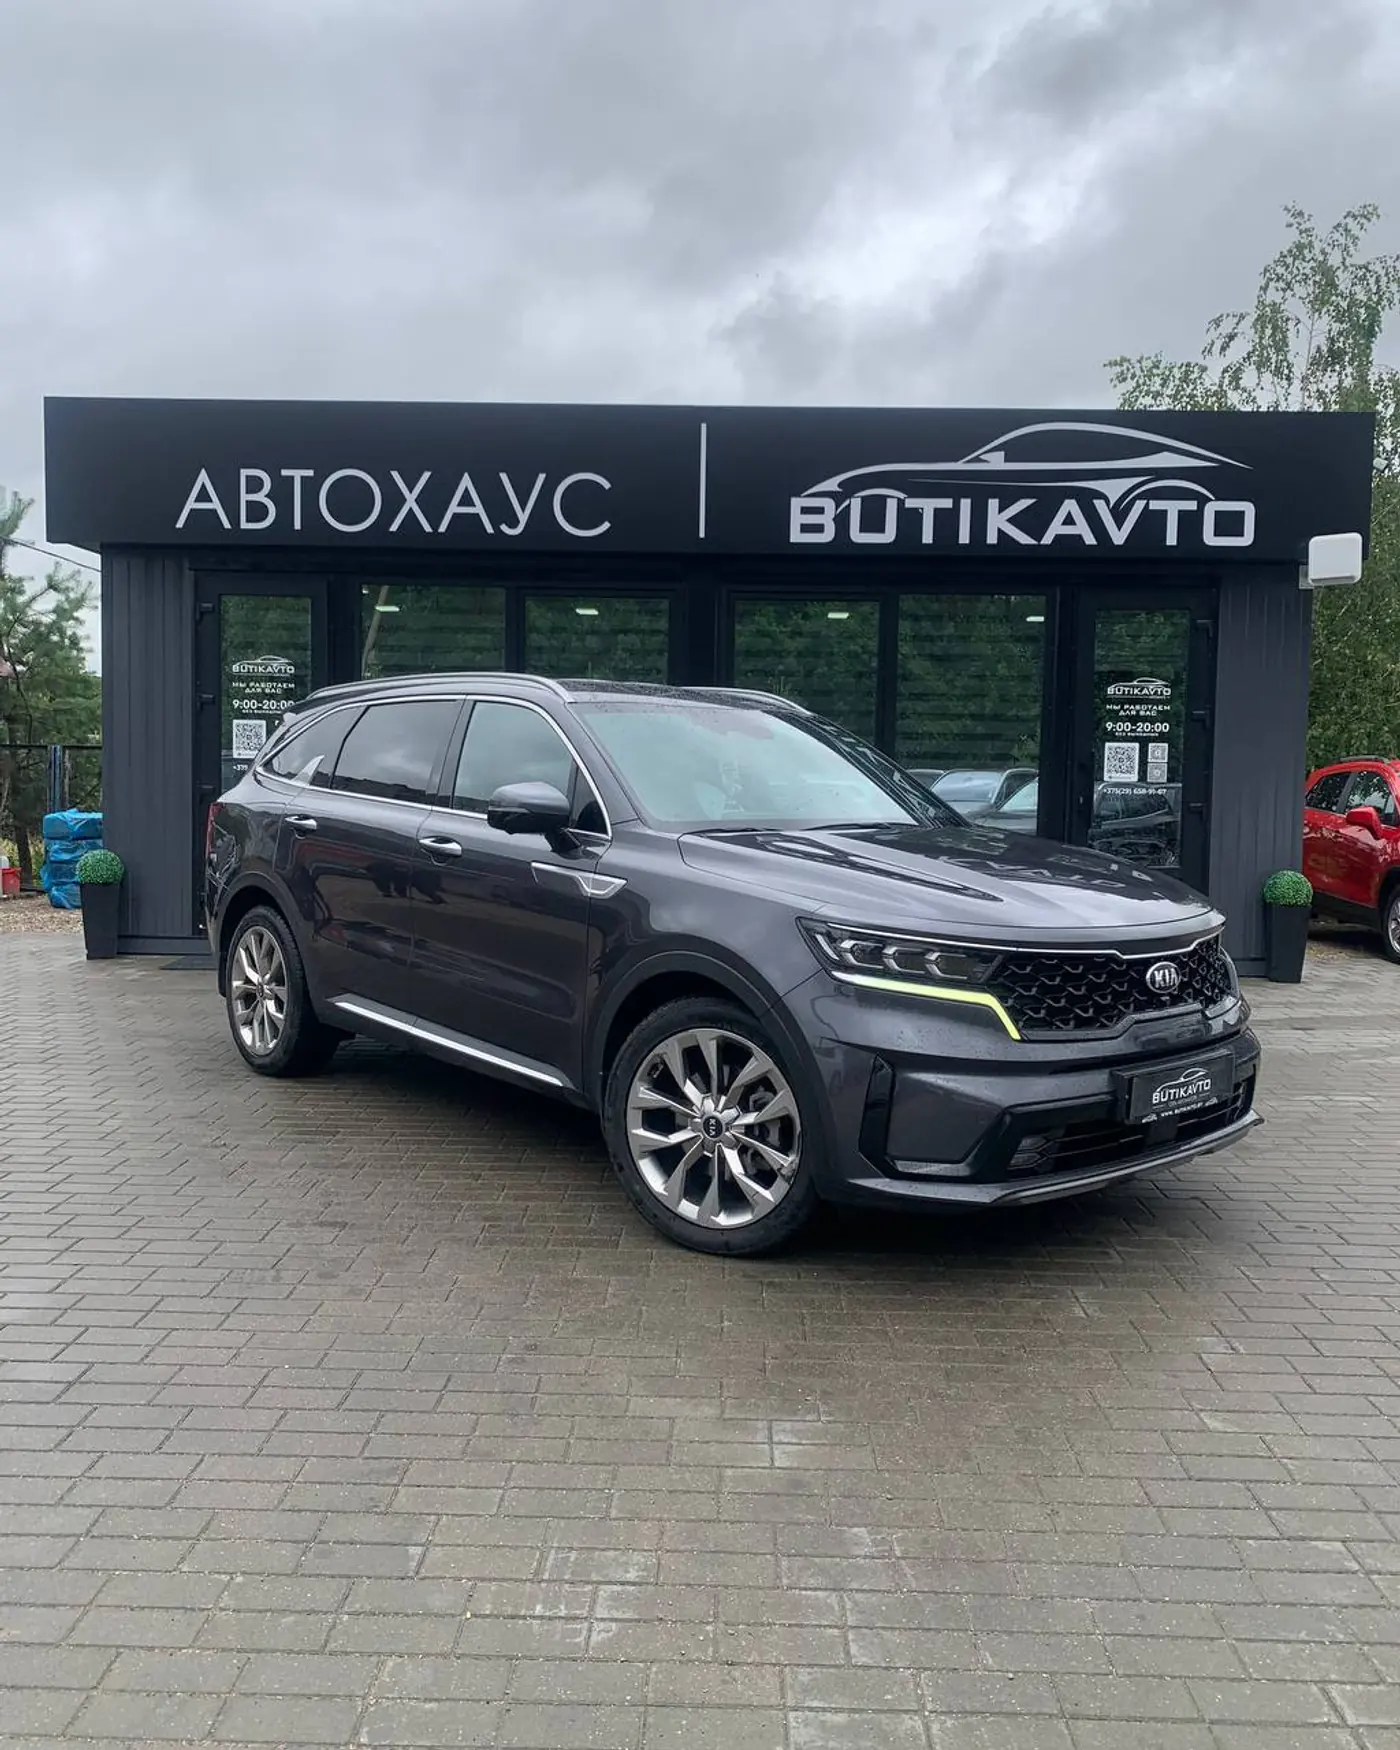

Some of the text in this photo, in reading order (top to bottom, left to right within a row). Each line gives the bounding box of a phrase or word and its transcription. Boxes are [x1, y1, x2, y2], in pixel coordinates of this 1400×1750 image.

[175, 467, 612, 537] АВТОХАУС
[789, 496, 1256, 547] BUTIKAVTO
[232, 664, 295, 674] BUTIKAVTO
[1107, 686, 1172, 696] BUTIKAVTO
[1105, 721, 1170, 733] 9:00-20:00
[1153, 967, 1178, 988] KIA
[1152, 1078, 1211, 1105] BUTIKAVTO
